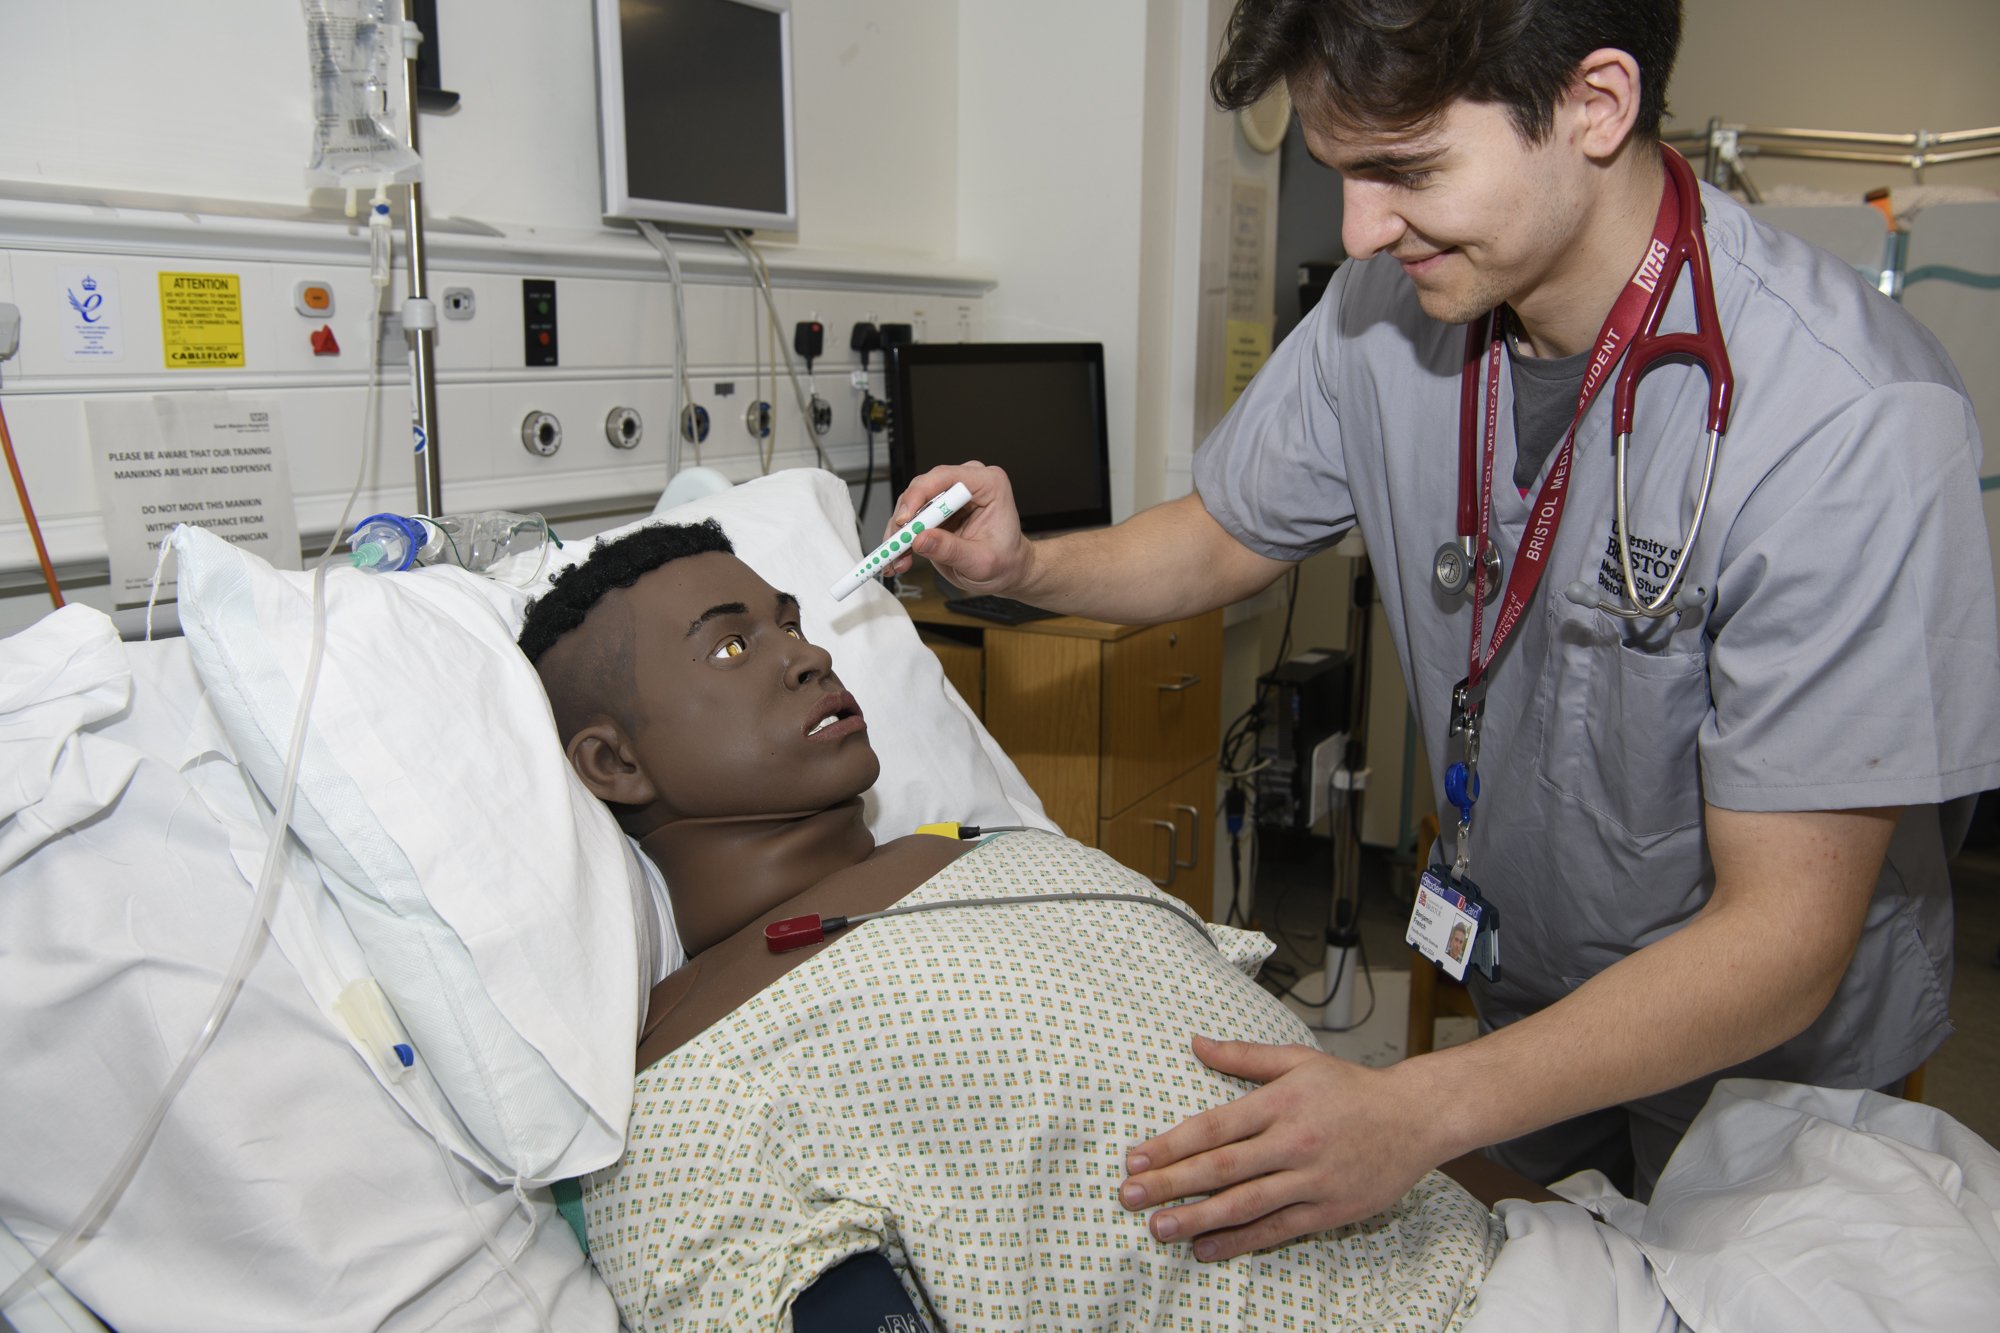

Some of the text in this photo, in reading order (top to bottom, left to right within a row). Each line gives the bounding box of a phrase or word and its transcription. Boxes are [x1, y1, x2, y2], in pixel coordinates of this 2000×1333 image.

[174, 278, 228, 290] ATTENTION
[1638, 240, 1669, 291] NHS
[1579, 327, 1621, 409] STUDENT
[108, 447, 272, 461] PLEASE BE AWARE THAT OUR TRAINING
[114, 464, 272, 479] MANIKINS ARE HEAVY AND EXPENSIVE
[1482, 460, 1492, 533] BRISTOL
[1487, 375, 1498, 452] MEDICAL
[142, 498, 262, 514] DO NOT MOVE THIS MANIKIN
[1526, 437, 1572, 561] BRISTOL MEDIC
[145, 515, 264, 532] WITHO ASSISTANCE FROM
[1612, 518, 1668, 558] Uersity
[1600, 558, 1668, 596] Medica Stud
[1606, 536, 1678, 579] BRSTO
[1598, 572, 1623, 596] Bristol
[1492, 591, 1517, 643] University of
[1494, 601, 1525, 649] BRISTOL
[1423, 876, 1444, 896] Student
